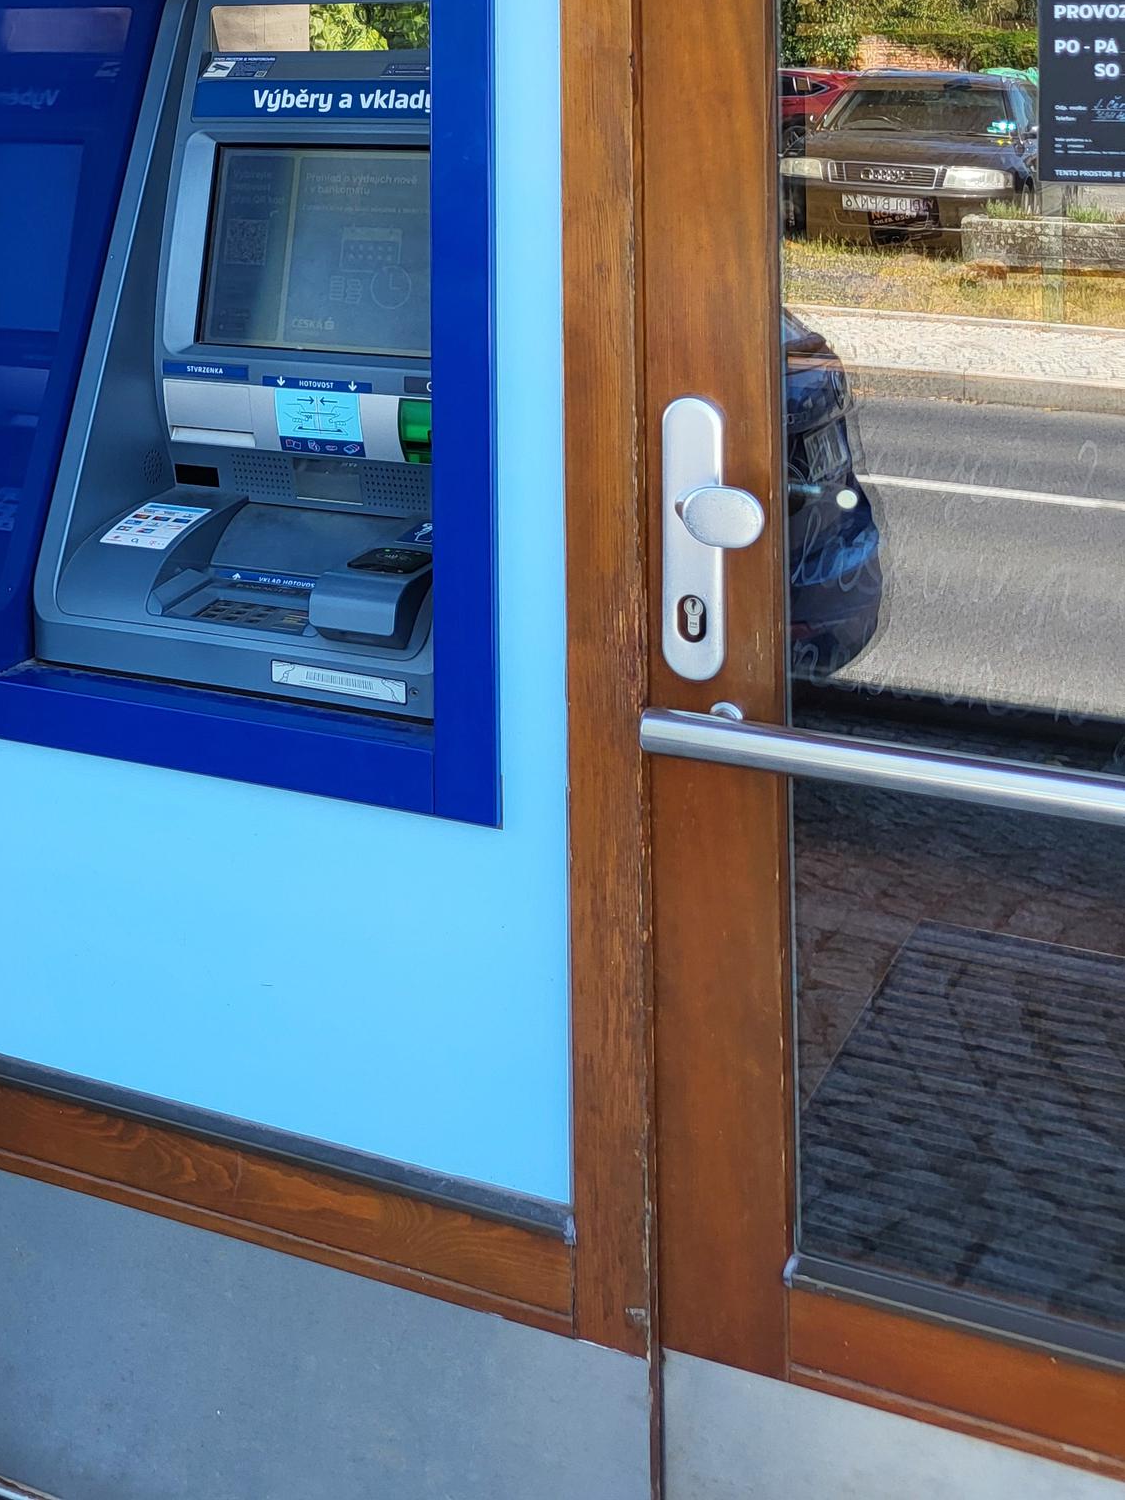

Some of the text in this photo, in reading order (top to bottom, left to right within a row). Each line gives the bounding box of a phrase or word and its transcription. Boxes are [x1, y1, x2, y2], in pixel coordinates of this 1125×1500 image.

[1054, 40, 1080, 53] PO
[1094, 38, 1118, 53] PÁ
[1094, 63, 1120, 77] SO
[253, 88, 334, 113] Výběry
[338, 94, 352, 109] a
[186, 365, 224, 375] STVRZENKA
[298, 380, 334, 389] HOTOVOST
[258, 576, 281, 584] VKLAD
[282, 579, 315, 589] HOTOVOS
